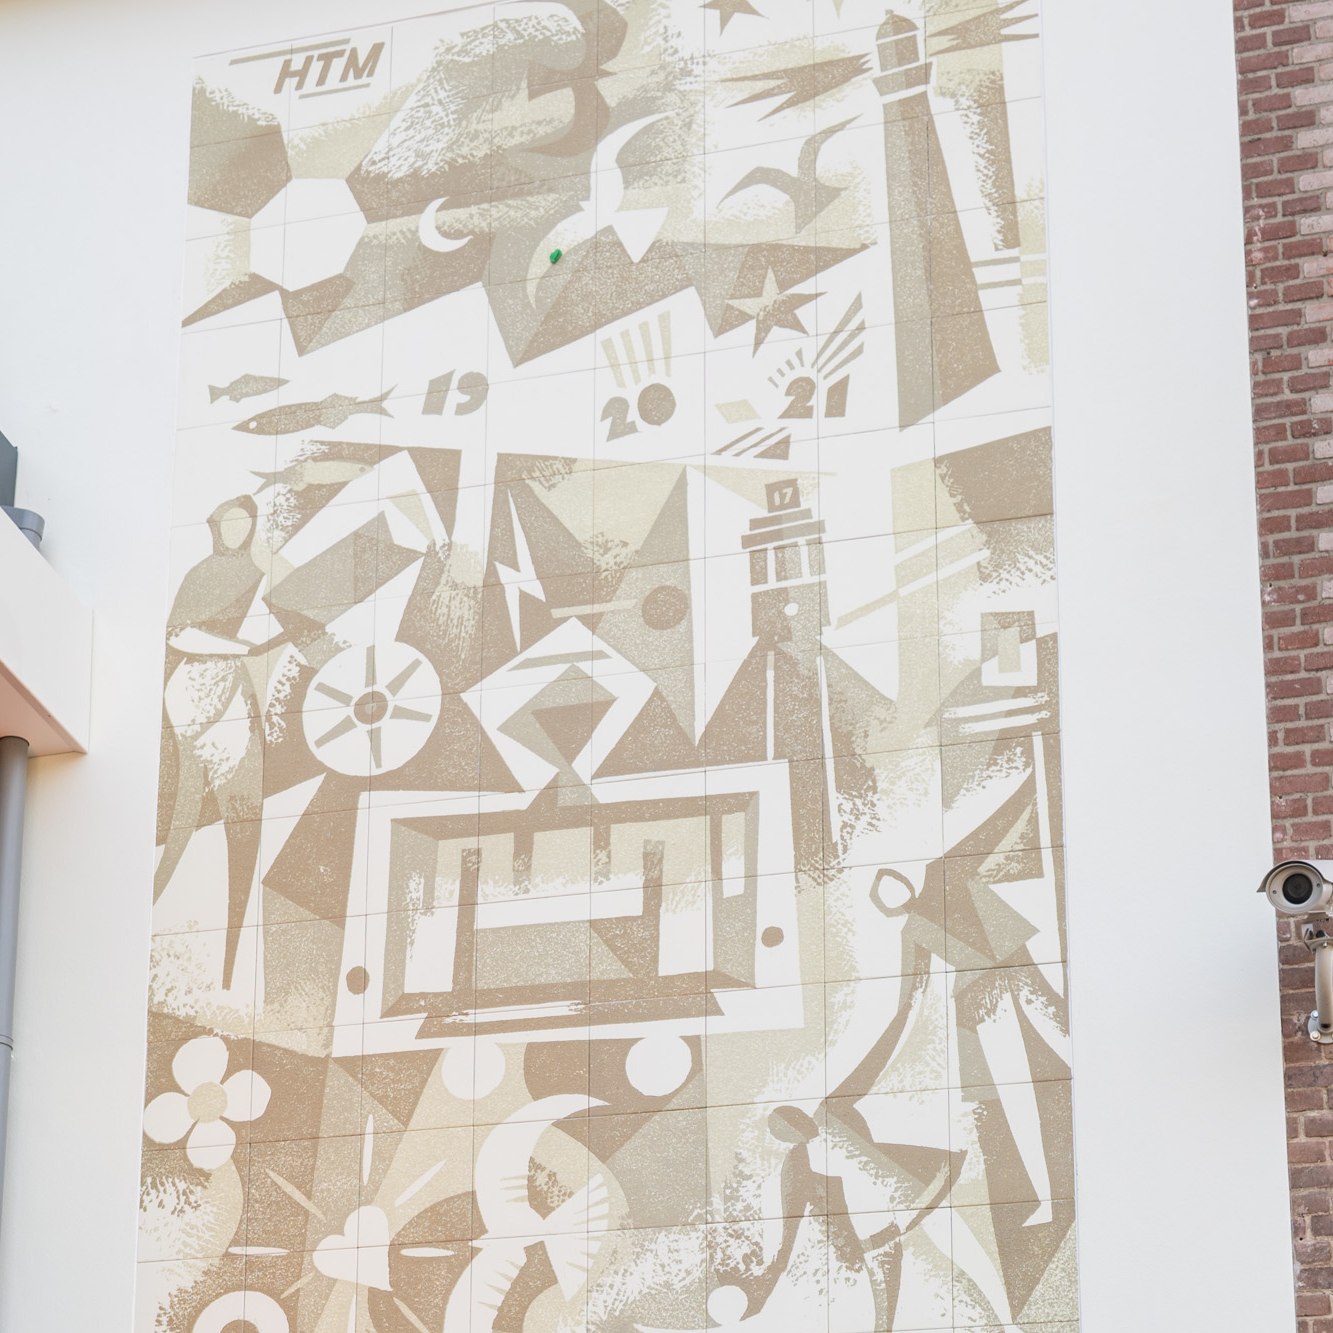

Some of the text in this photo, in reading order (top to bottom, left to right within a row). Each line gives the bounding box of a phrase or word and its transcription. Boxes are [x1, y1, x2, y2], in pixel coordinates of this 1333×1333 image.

[273, 42, 385, 95] HTM
[421, 369, 490, 416] 19
[600, 383, 677, 442] 20
[777, 374, 850, 419] 21
[773, 487, 794, 506] 17
